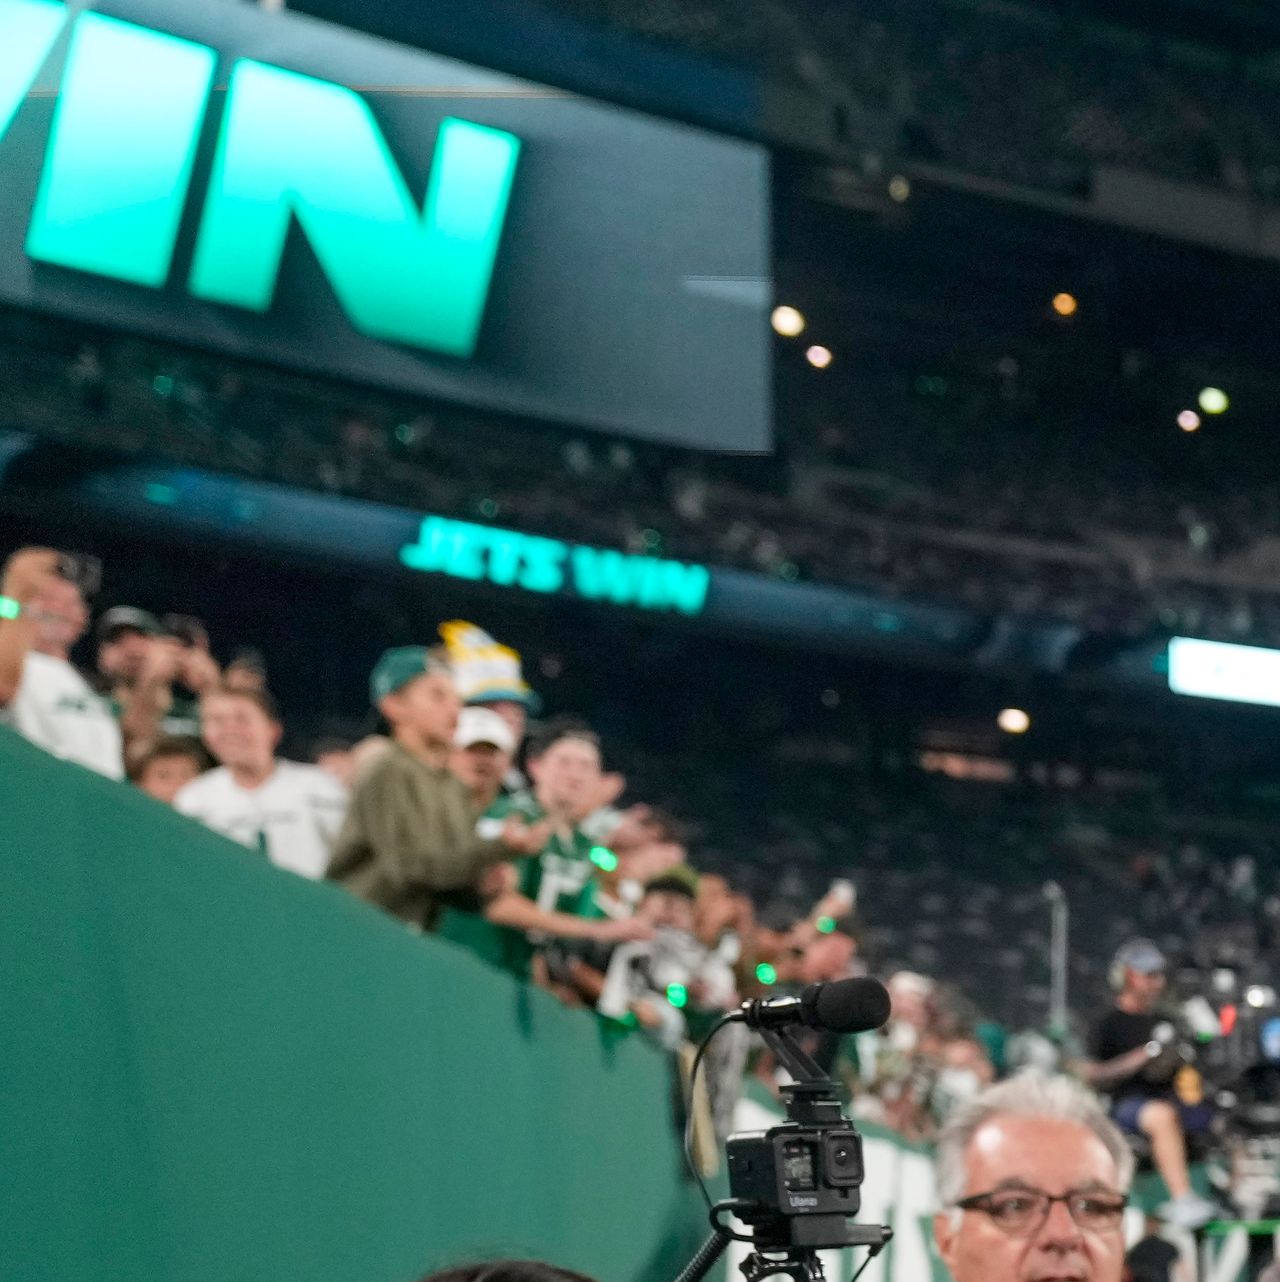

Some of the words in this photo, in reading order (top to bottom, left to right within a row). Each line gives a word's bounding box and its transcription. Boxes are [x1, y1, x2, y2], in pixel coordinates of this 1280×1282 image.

[0, 0, 522, 358] IN
[400, 514, 569, 592] JETS
[570, 545, 711, 616] WIN
